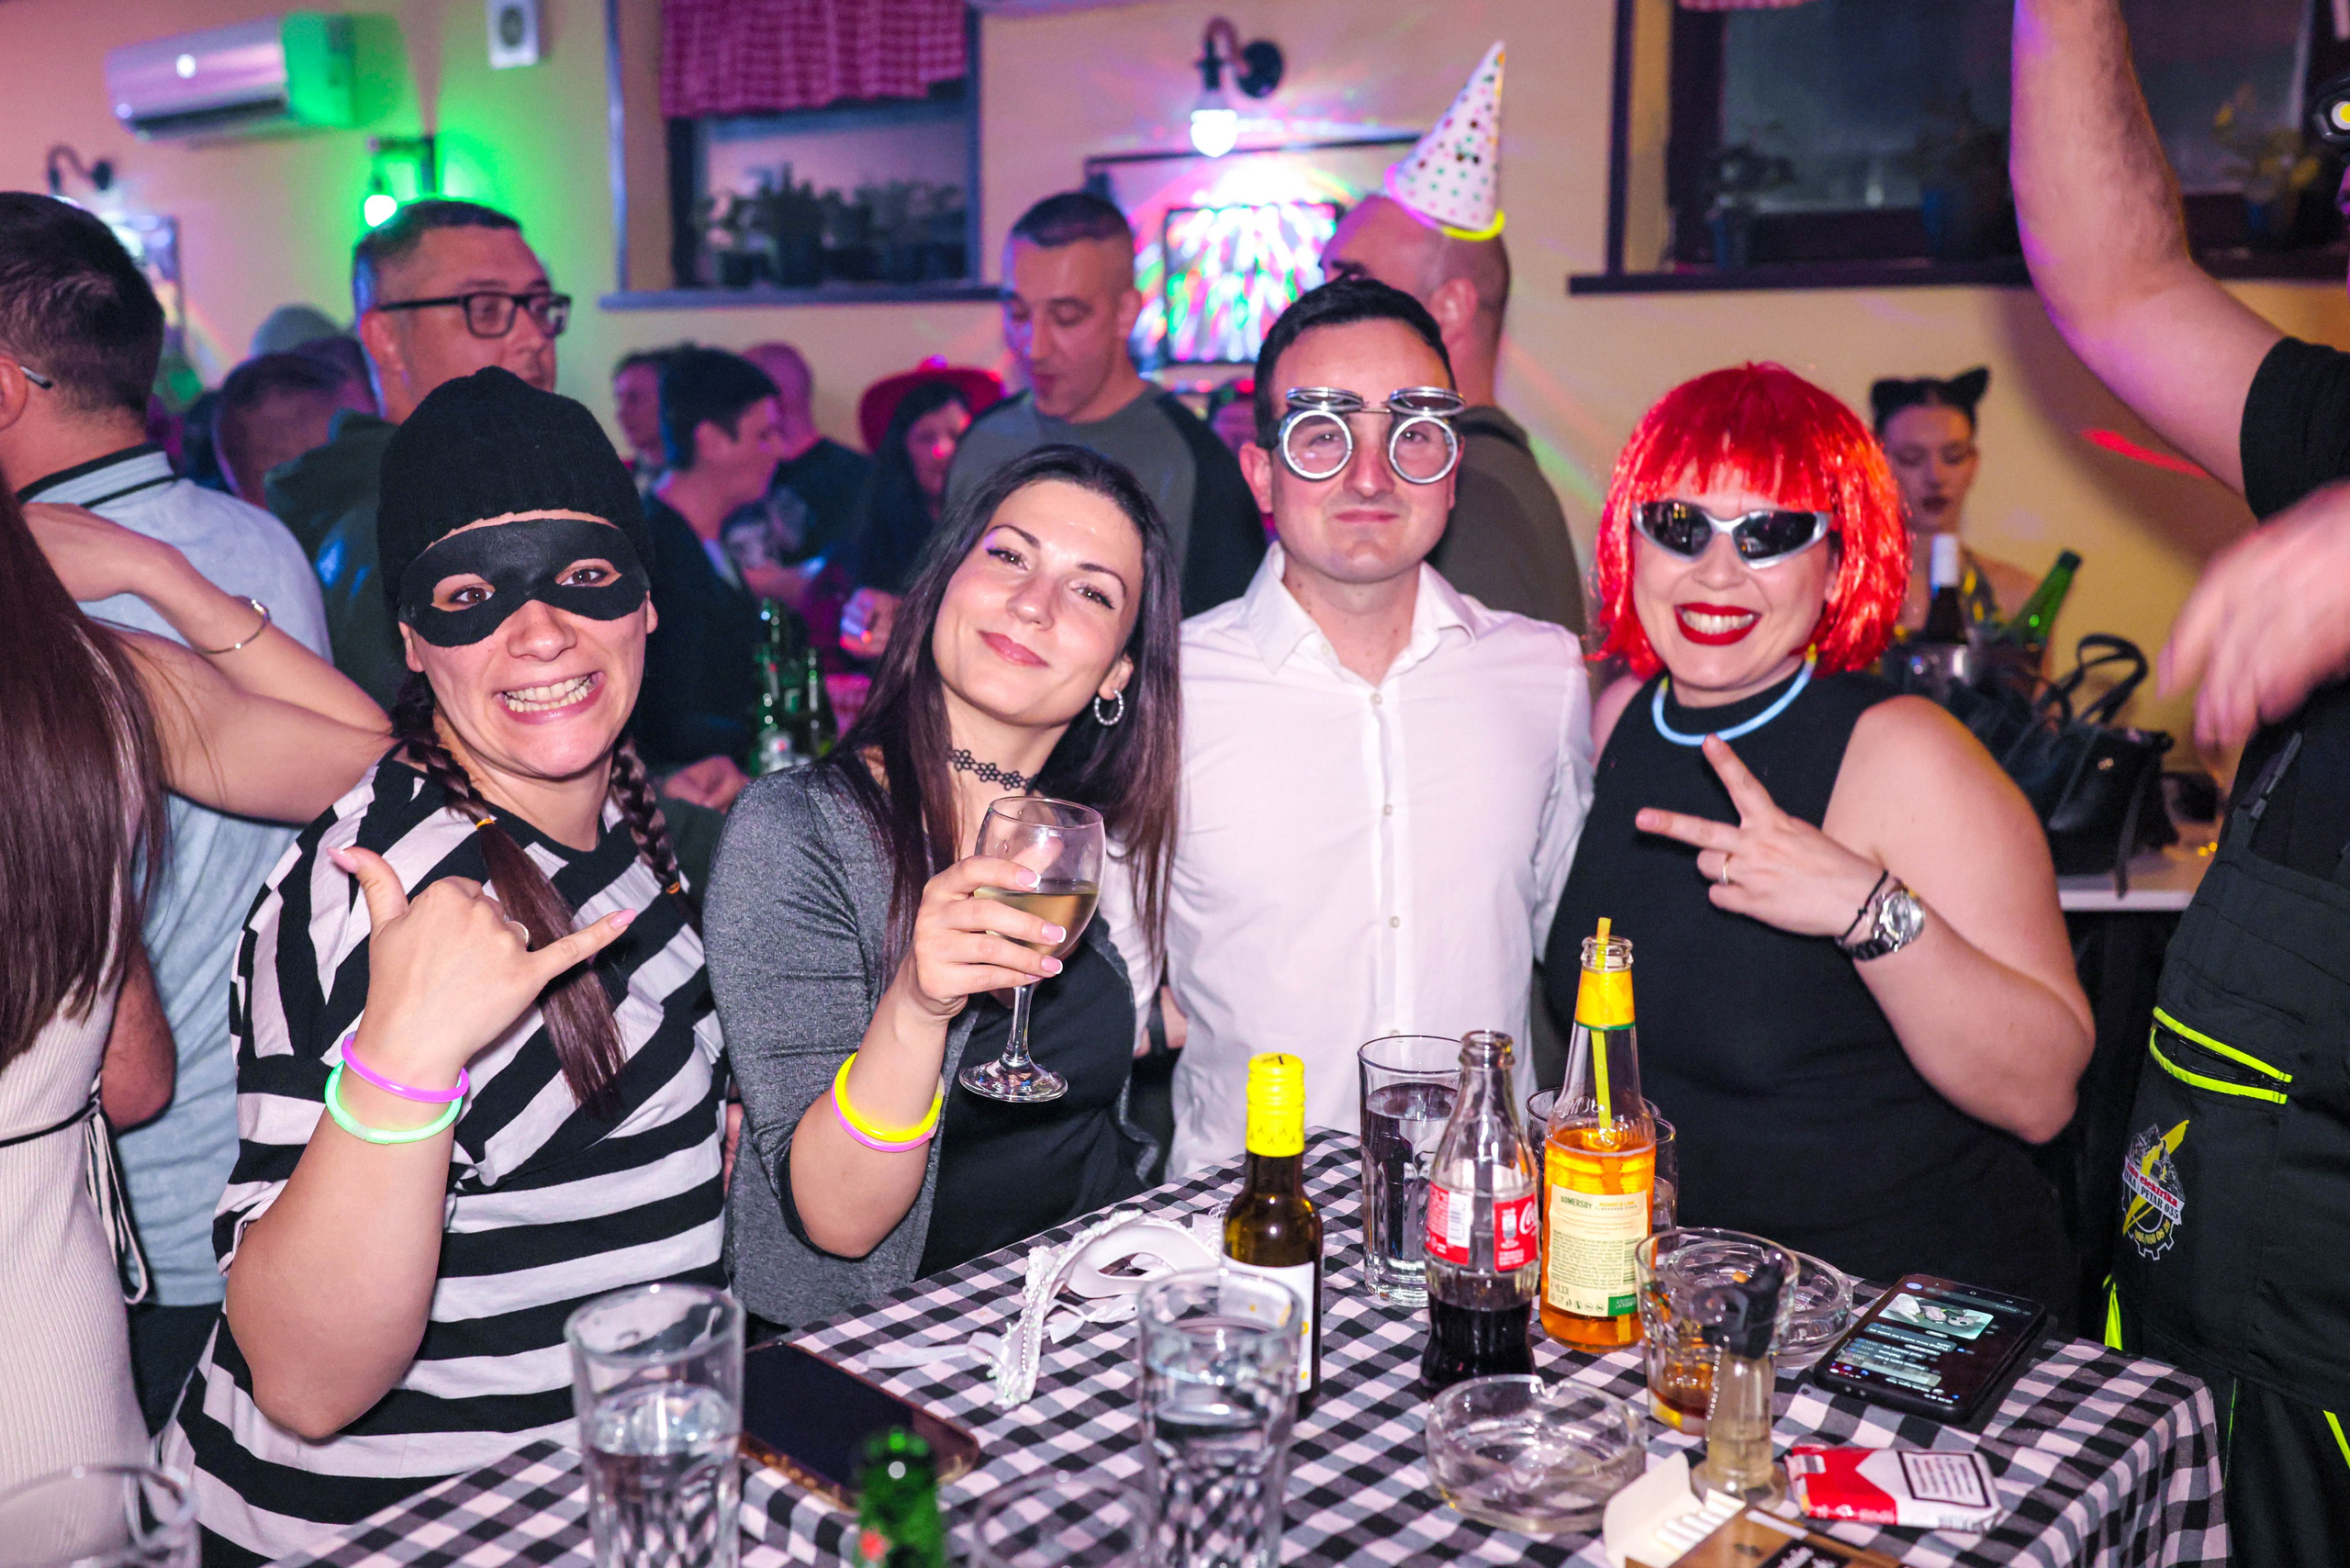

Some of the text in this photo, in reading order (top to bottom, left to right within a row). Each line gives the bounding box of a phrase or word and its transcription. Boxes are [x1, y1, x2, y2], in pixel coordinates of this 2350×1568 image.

[1561, 1195, 1593, 1210] SOMERSBY
[2140, 1176, 2178, 1207] elektrika
[2141, 1185, 2163, 1208] PETAR
[2164, 1203, 2179, 1219] 035
